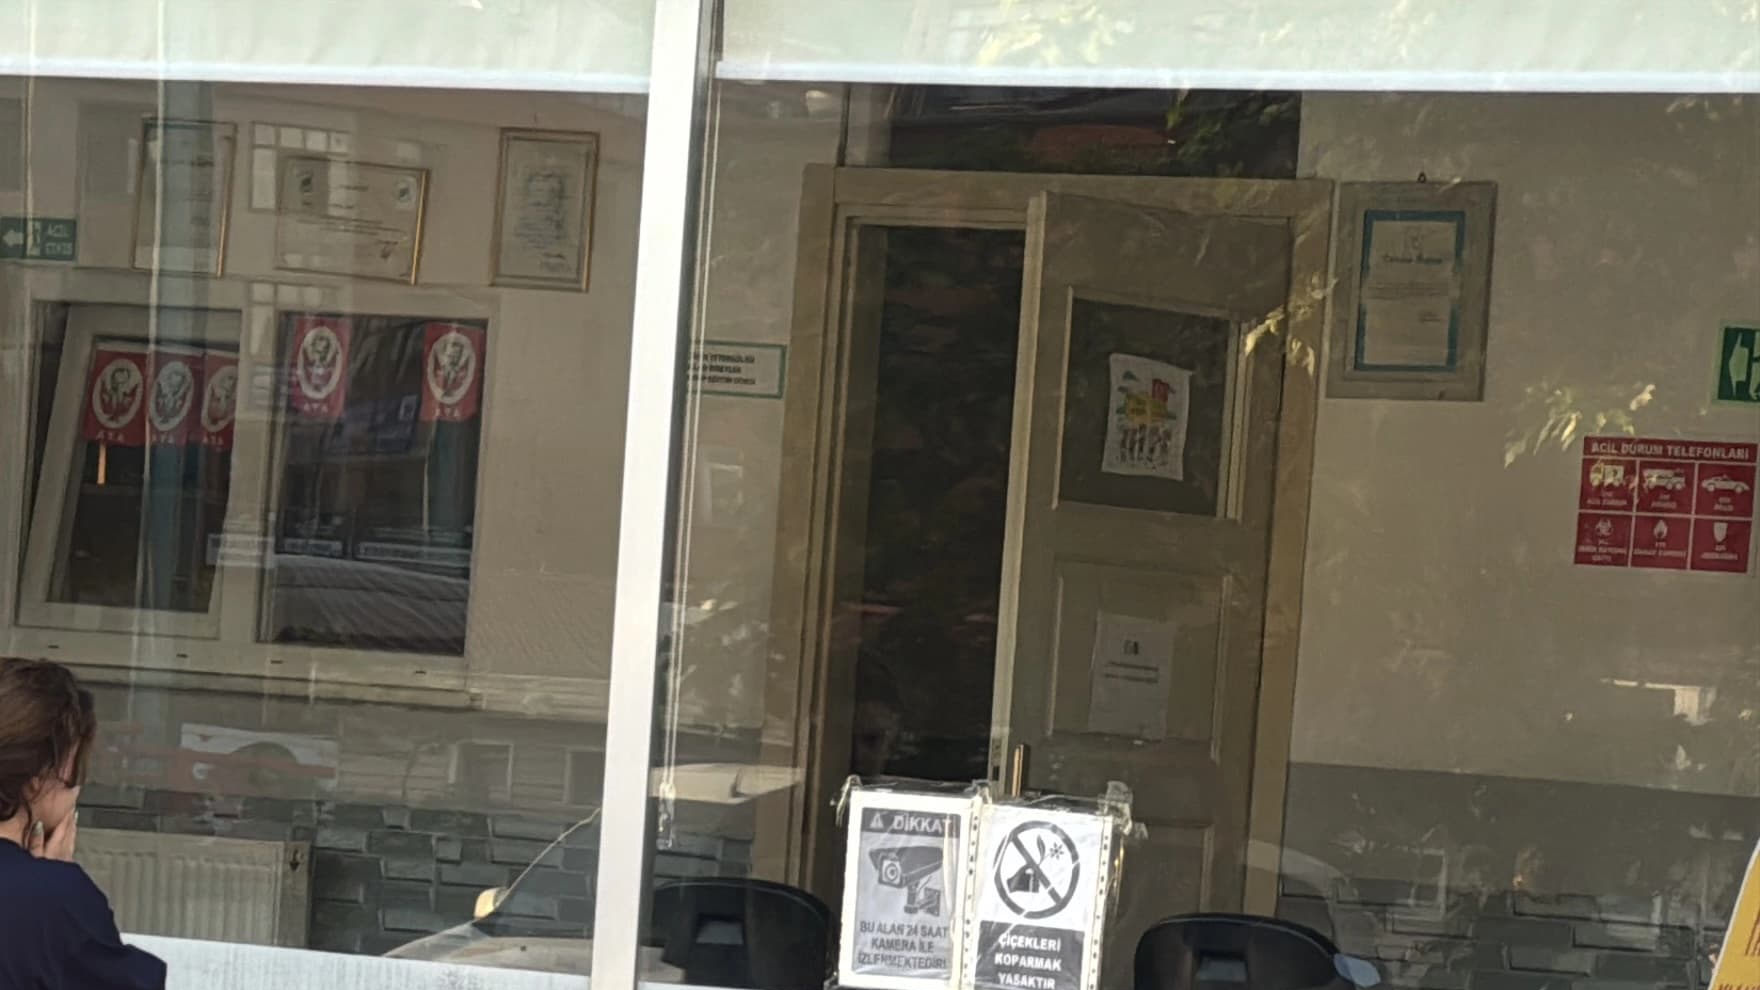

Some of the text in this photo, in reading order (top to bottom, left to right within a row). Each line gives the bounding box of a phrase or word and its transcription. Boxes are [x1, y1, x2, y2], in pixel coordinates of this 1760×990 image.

[1591, 440, 1749, 460] ACİL DURUM TELEFONLARI
[891, 812, 952, 834] DİKKAT
[860, 920, 949, 939] BU ALAN 24 SAAT
[871, 938, 935, 953] KAMERA İLE
[998, 933, 1061, 952] ÇİÇEKLERİ
[994, 952, 1062, 971] KOPARMAK
[998, 972, 1056, 990] YASAKTIR
